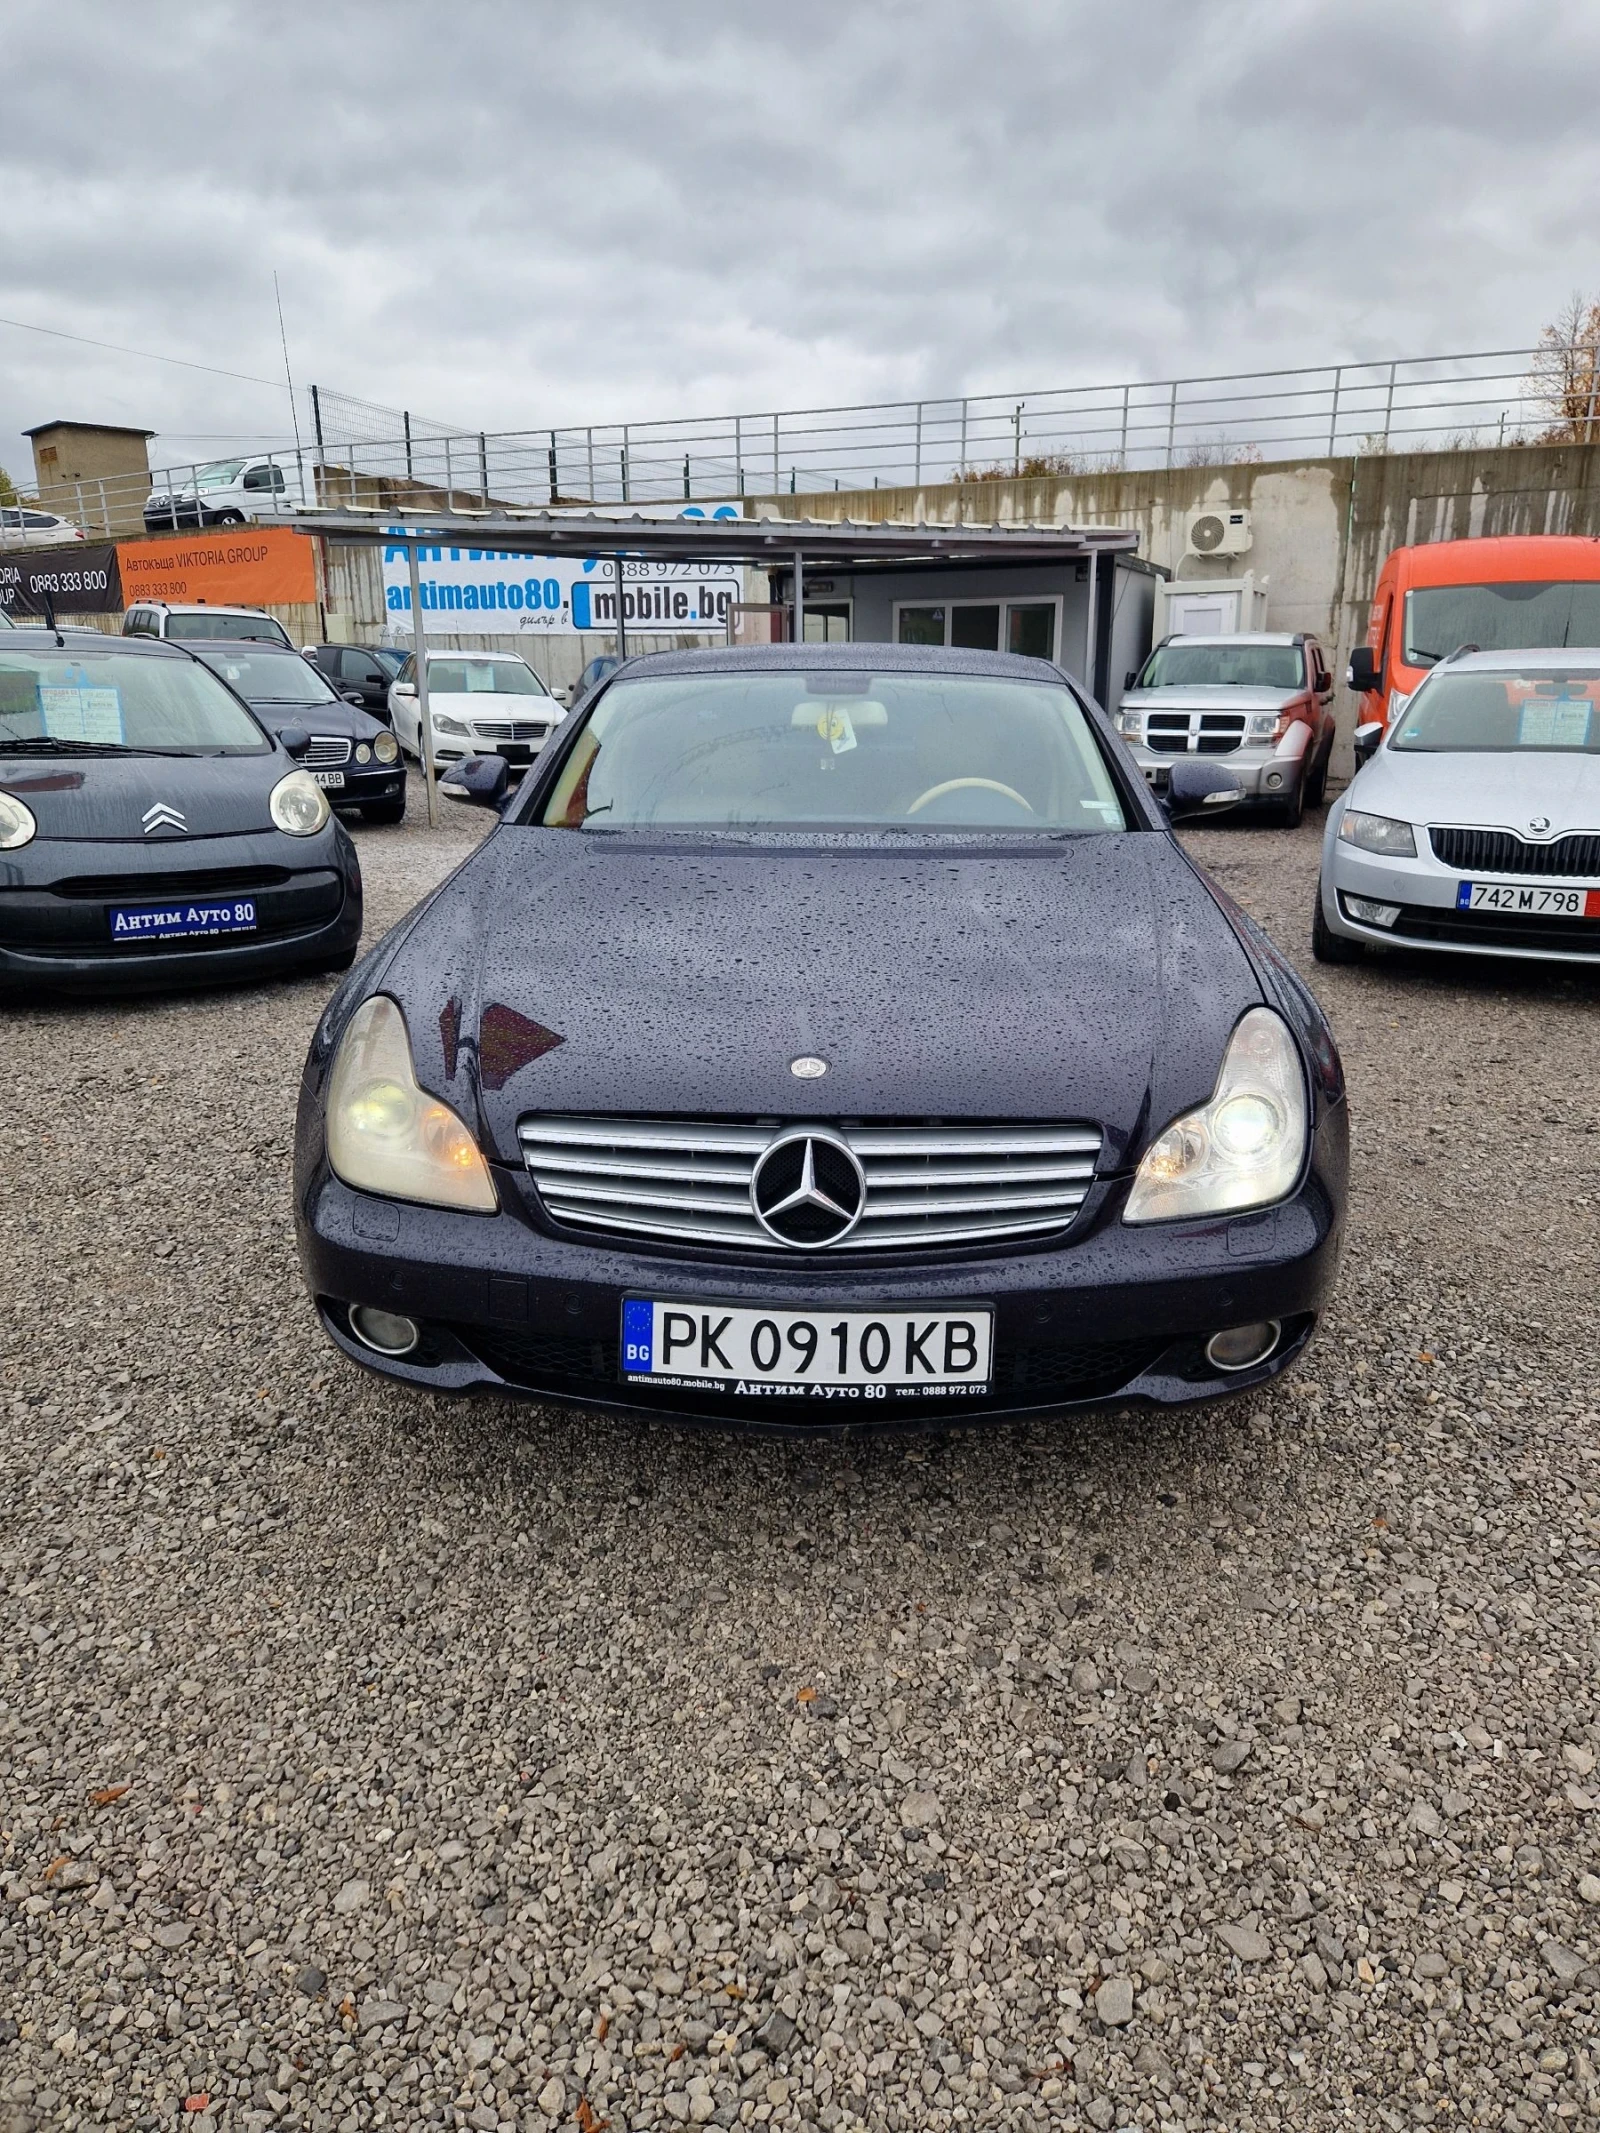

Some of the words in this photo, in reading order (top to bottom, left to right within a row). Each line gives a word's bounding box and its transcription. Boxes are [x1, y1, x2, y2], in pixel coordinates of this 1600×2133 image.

[126, 557, 175, 572] Автокъща
[176, 550, 226, 568] VIKTORIA
[227, 545, 268, 564] GROUP
[30, 573, 59, 594] 0883
[61, 571, 82, 592] 333
[83, 570, 107, 591] 800
[129, 582, 150, 597] 0883
[152, 582, 168, 596] 333
[169, 581, 187, 595] 800
[1474, 887, 1515, 909] 742
[1518, 890, 1534, 910] M
[1538, 891, 1579, 912] 798
[114, 912, 182, 931] Антим
[186, 907, 231, 925] Ауто
[234, 903, 255, 922] 80
[627, 1344, 650, 1361] BG
[662, 1312, 734, 1370] PK
[751, 1319, 891, 1374] 0910
[905, 1321, 978, 1374] KB
[627, 1374, 726, 1391] antimauto80.mobile.bg
[734, 1380, 805, 1395] Антим
[810, 1385, 860, 1399] Ауто
[864, 1384, 887, 1399] 80
[895, 1387, 921, 1396] тел.:
[922, 1386, 947, 1395] 0888
[948, 1386, 967, 1395] 972
[969, 1385, 988, 1394] 073
